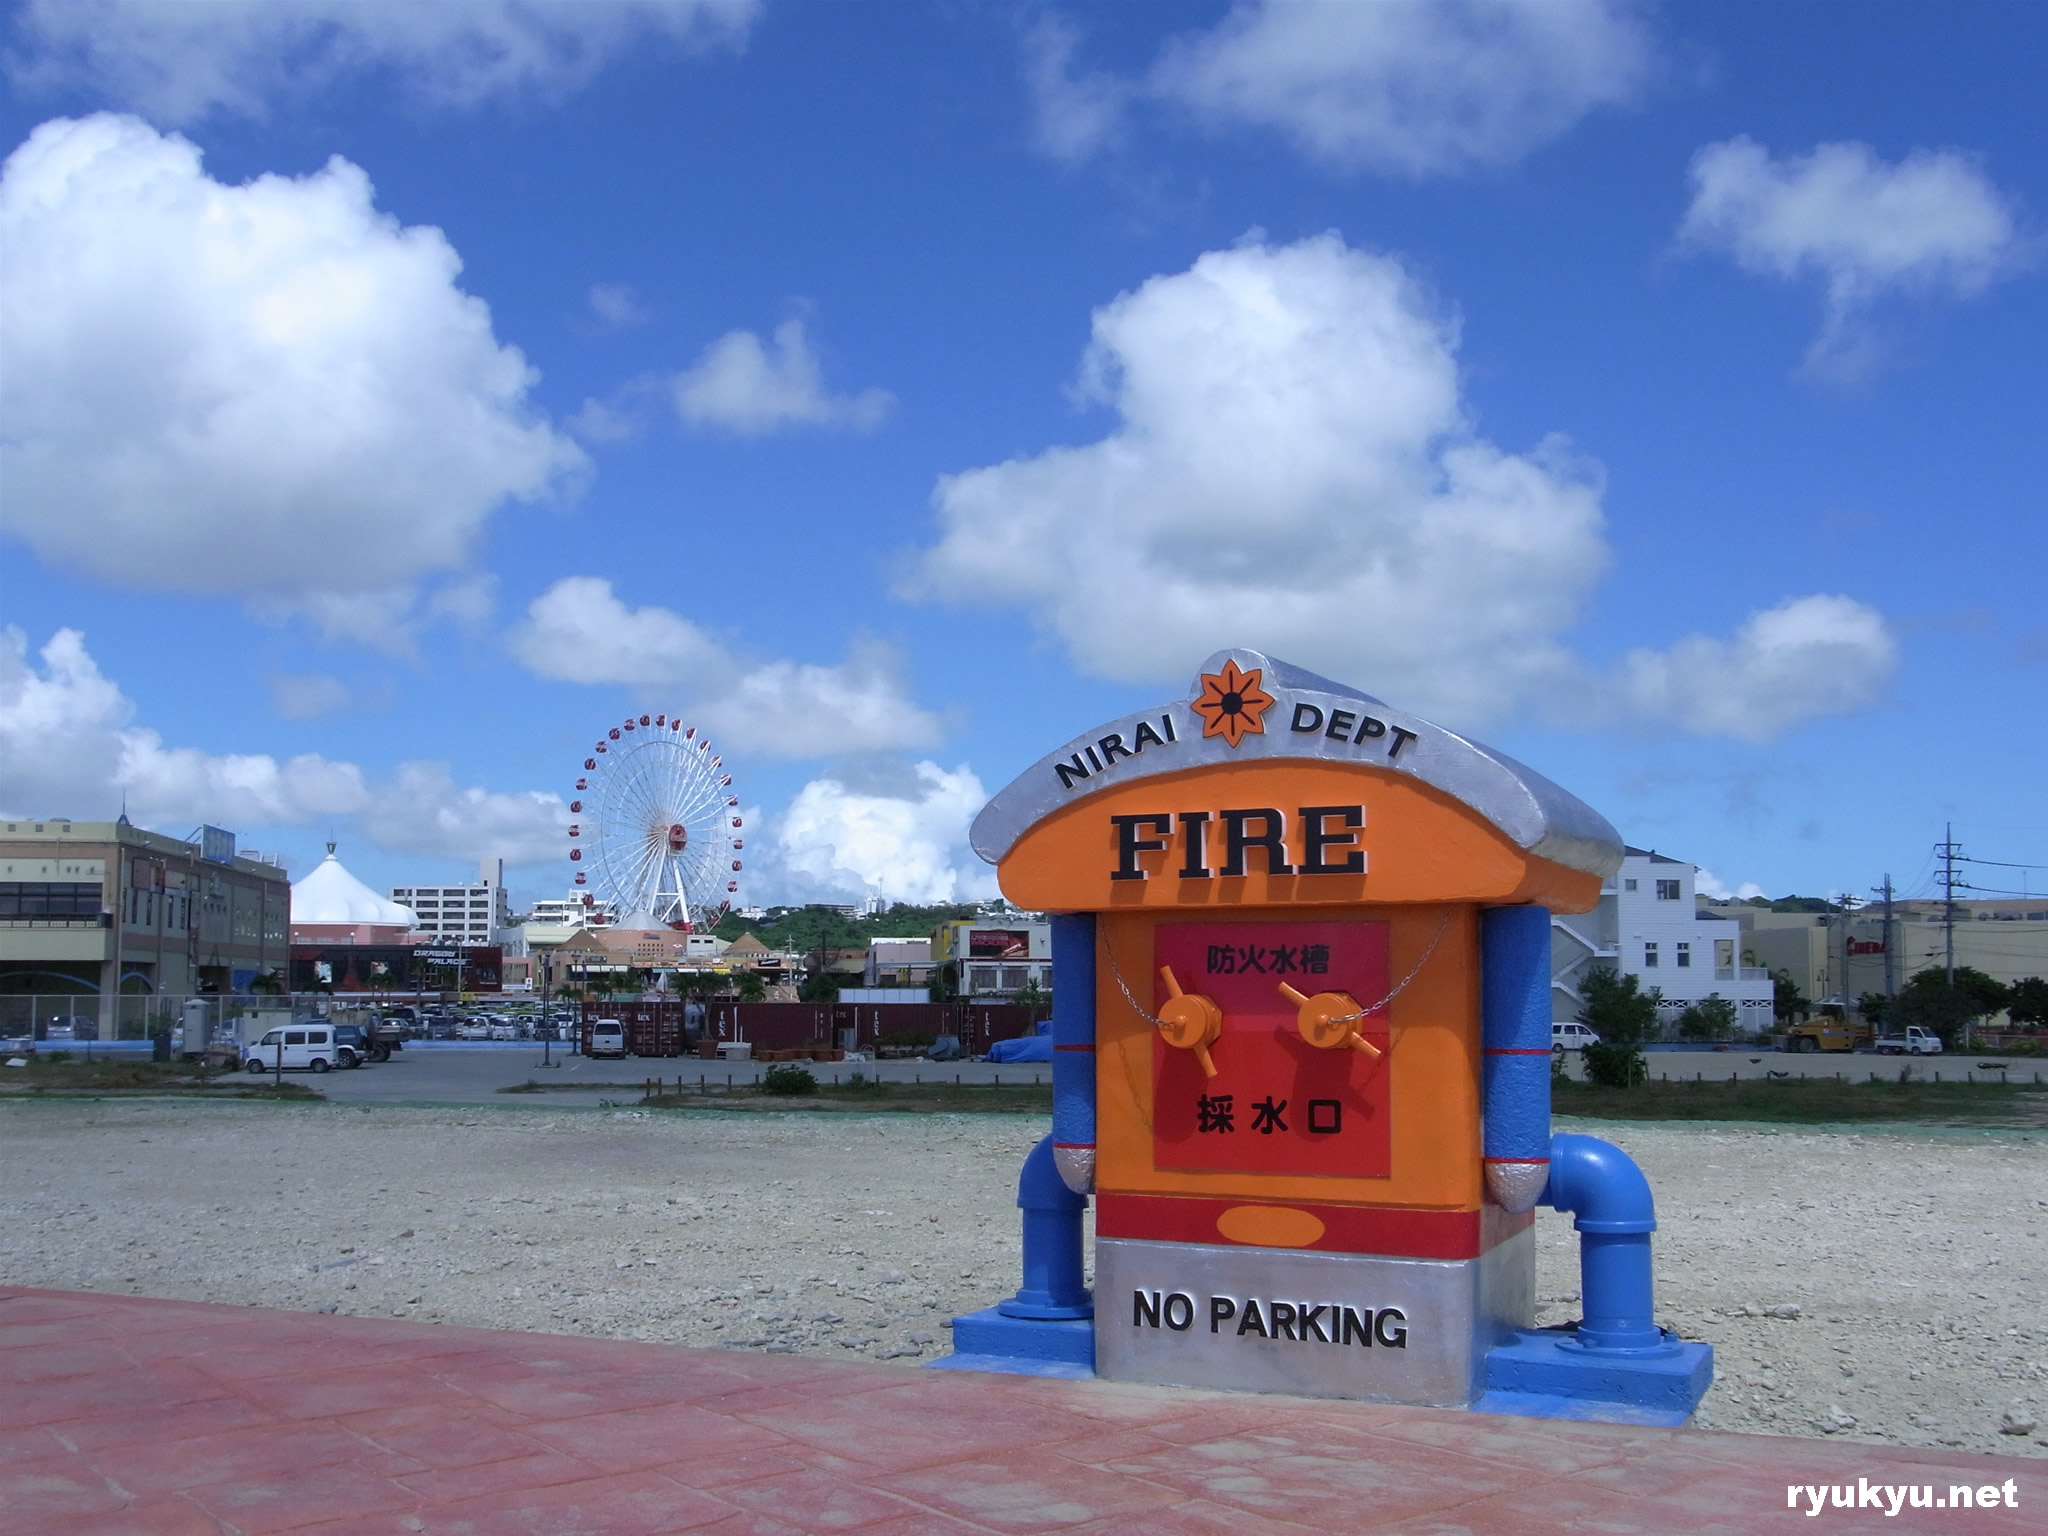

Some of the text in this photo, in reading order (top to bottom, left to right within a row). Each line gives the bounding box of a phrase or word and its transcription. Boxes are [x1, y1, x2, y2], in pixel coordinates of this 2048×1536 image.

[1054, 702, 1419, 790] NIRAI DEPT
[1110, 805, 1368, 880] FIRE
[1207, 944, 1329, 976] 防火水槽
[637, 1013, 650, 1021] tex
[718, 1010, 726, 1037] tex
[1134, 1290, 1408, 1350] NO PARKING
